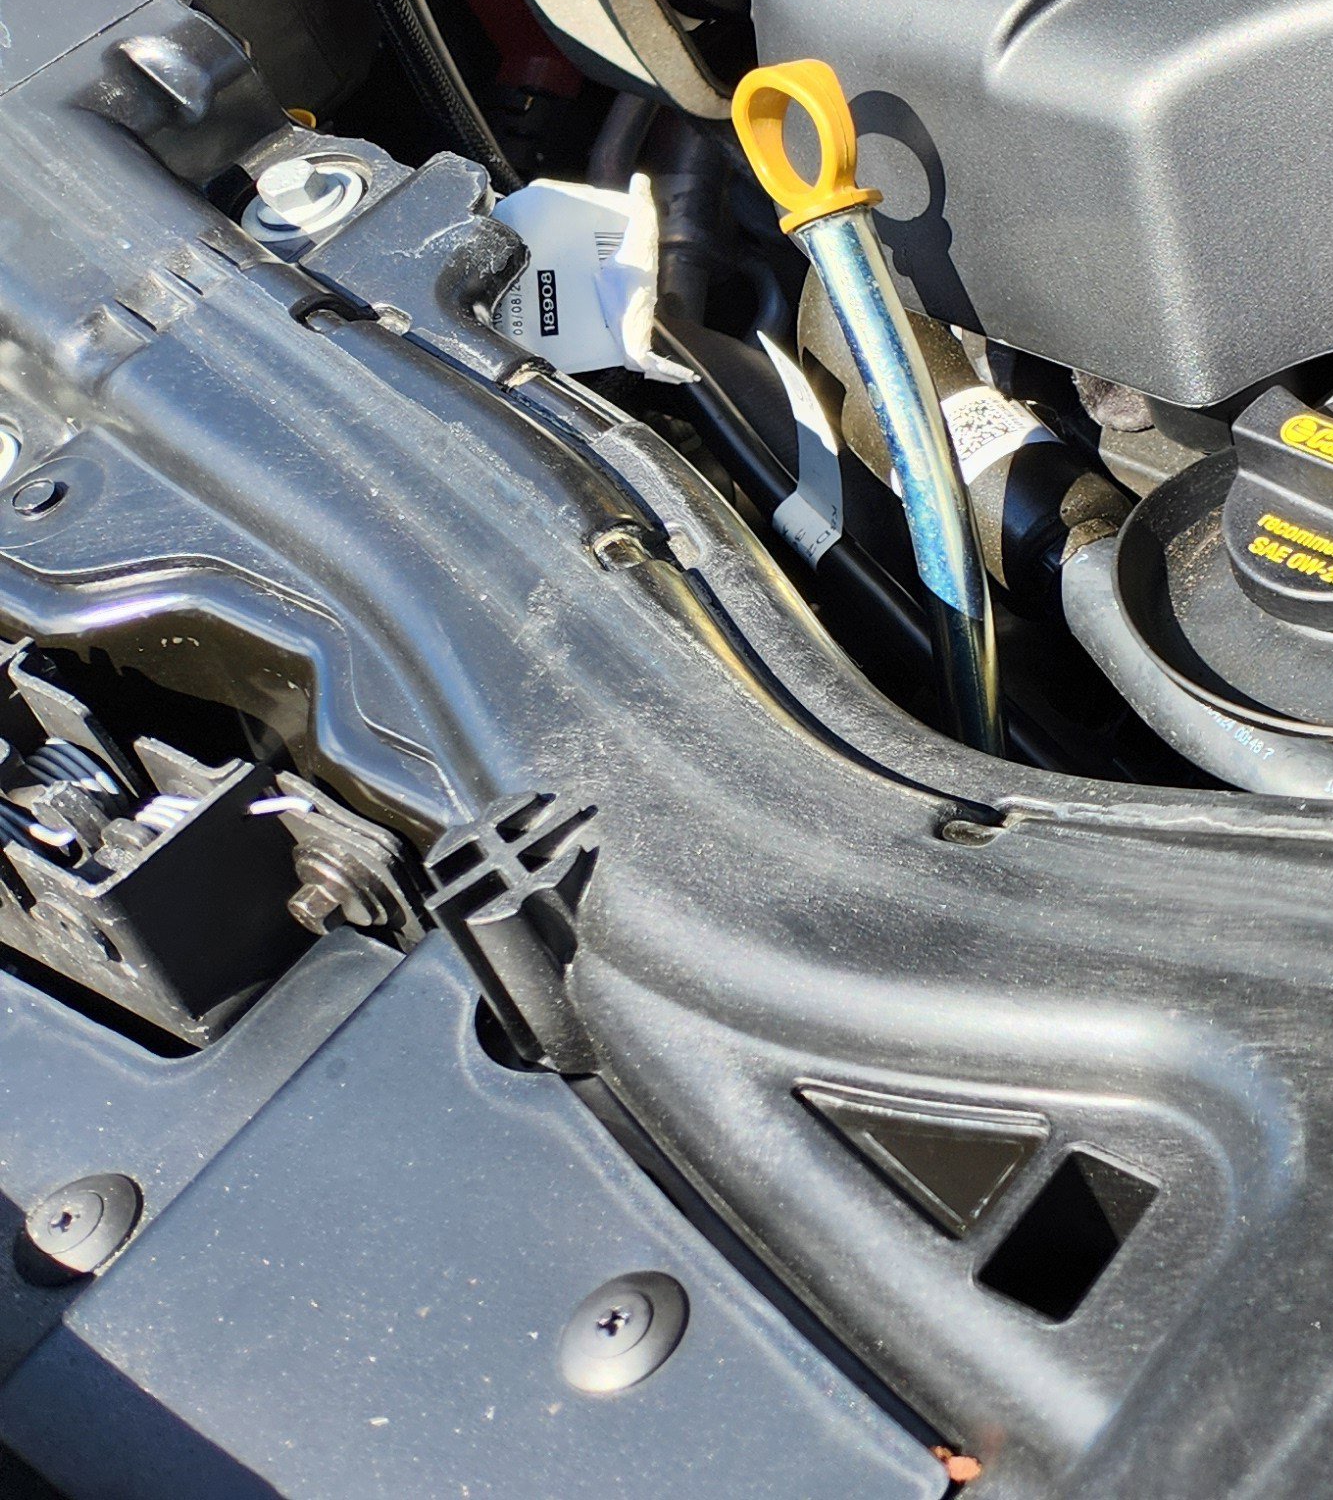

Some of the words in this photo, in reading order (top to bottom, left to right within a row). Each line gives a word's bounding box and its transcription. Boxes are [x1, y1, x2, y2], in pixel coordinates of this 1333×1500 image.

[510, 281, 523, 336] 08/08/2
[540, 271, 556, 333] 18908
[1248, 536, 1290, 565] SAE
